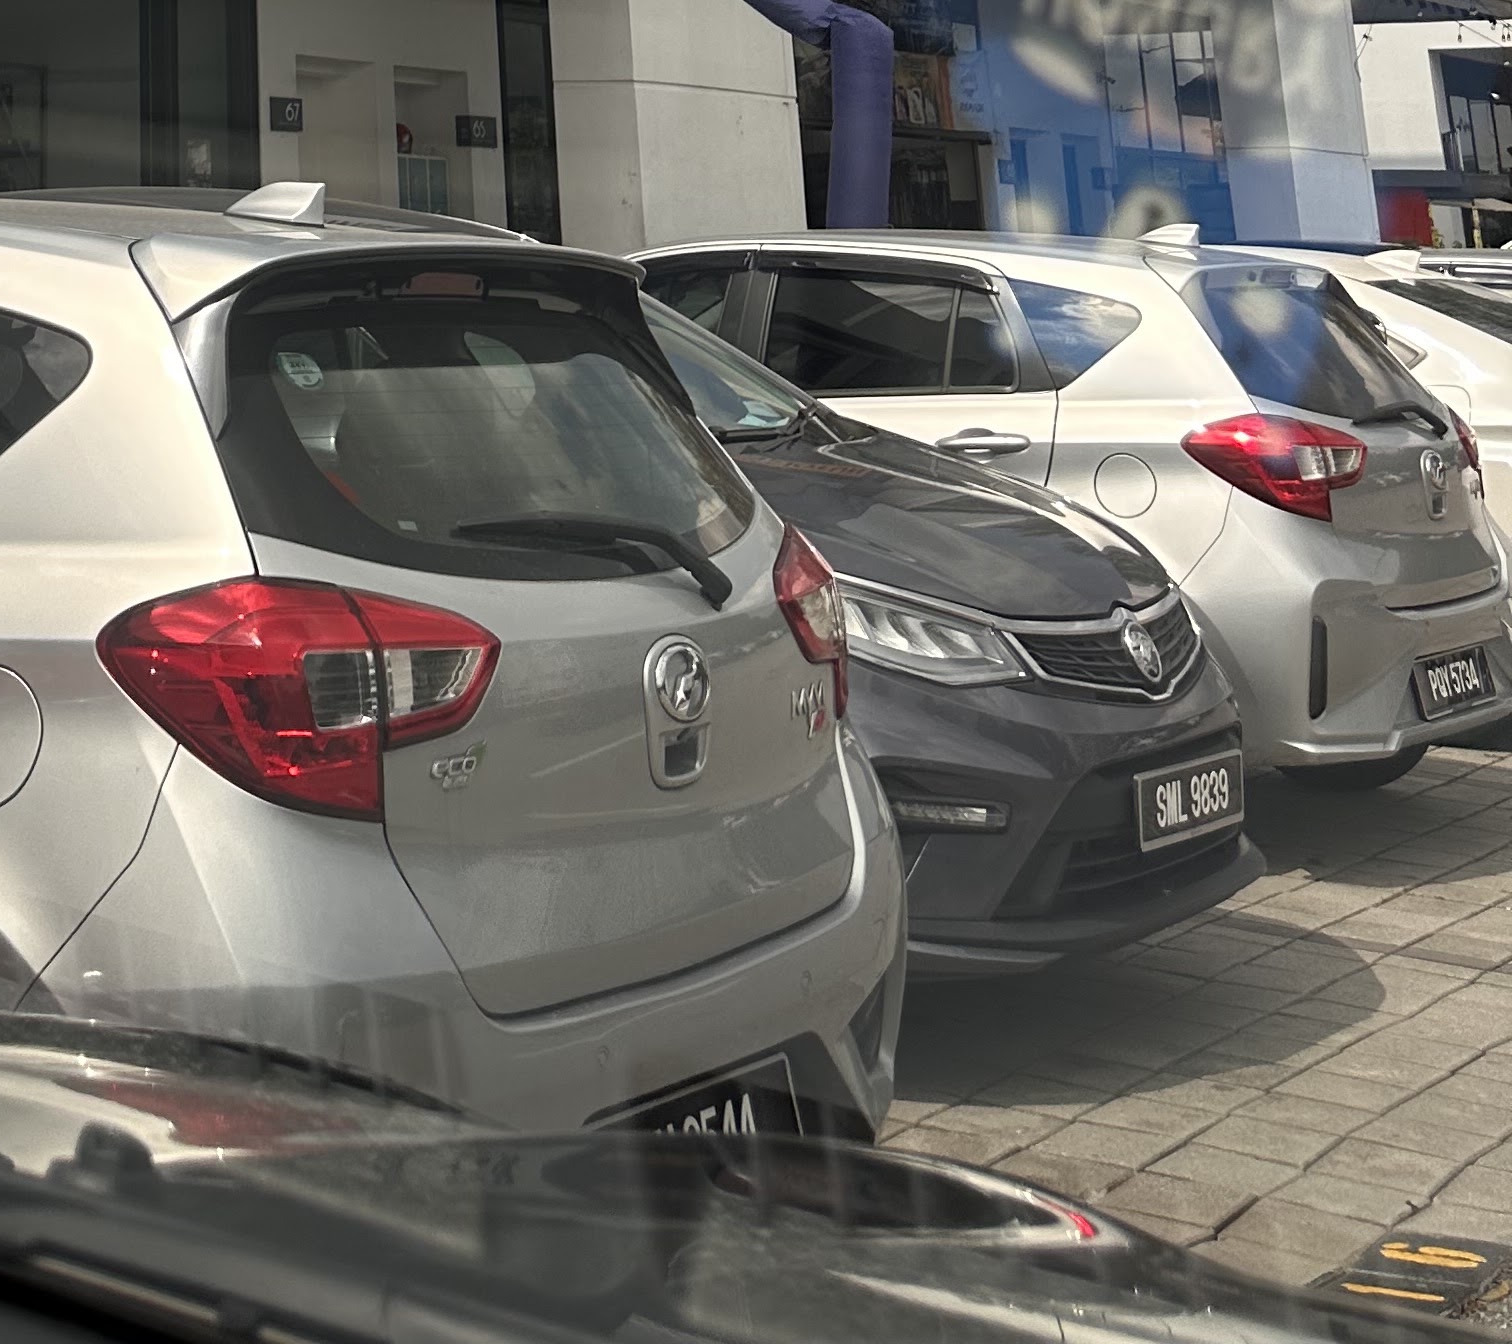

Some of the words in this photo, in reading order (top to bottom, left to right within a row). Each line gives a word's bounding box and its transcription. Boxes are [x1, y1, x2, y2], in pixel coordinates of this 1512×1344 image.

[285, 102, 300, 122] 67
[1156, 780, 1188, 828] SML
[1190, 767, 1229, 818] 9839
